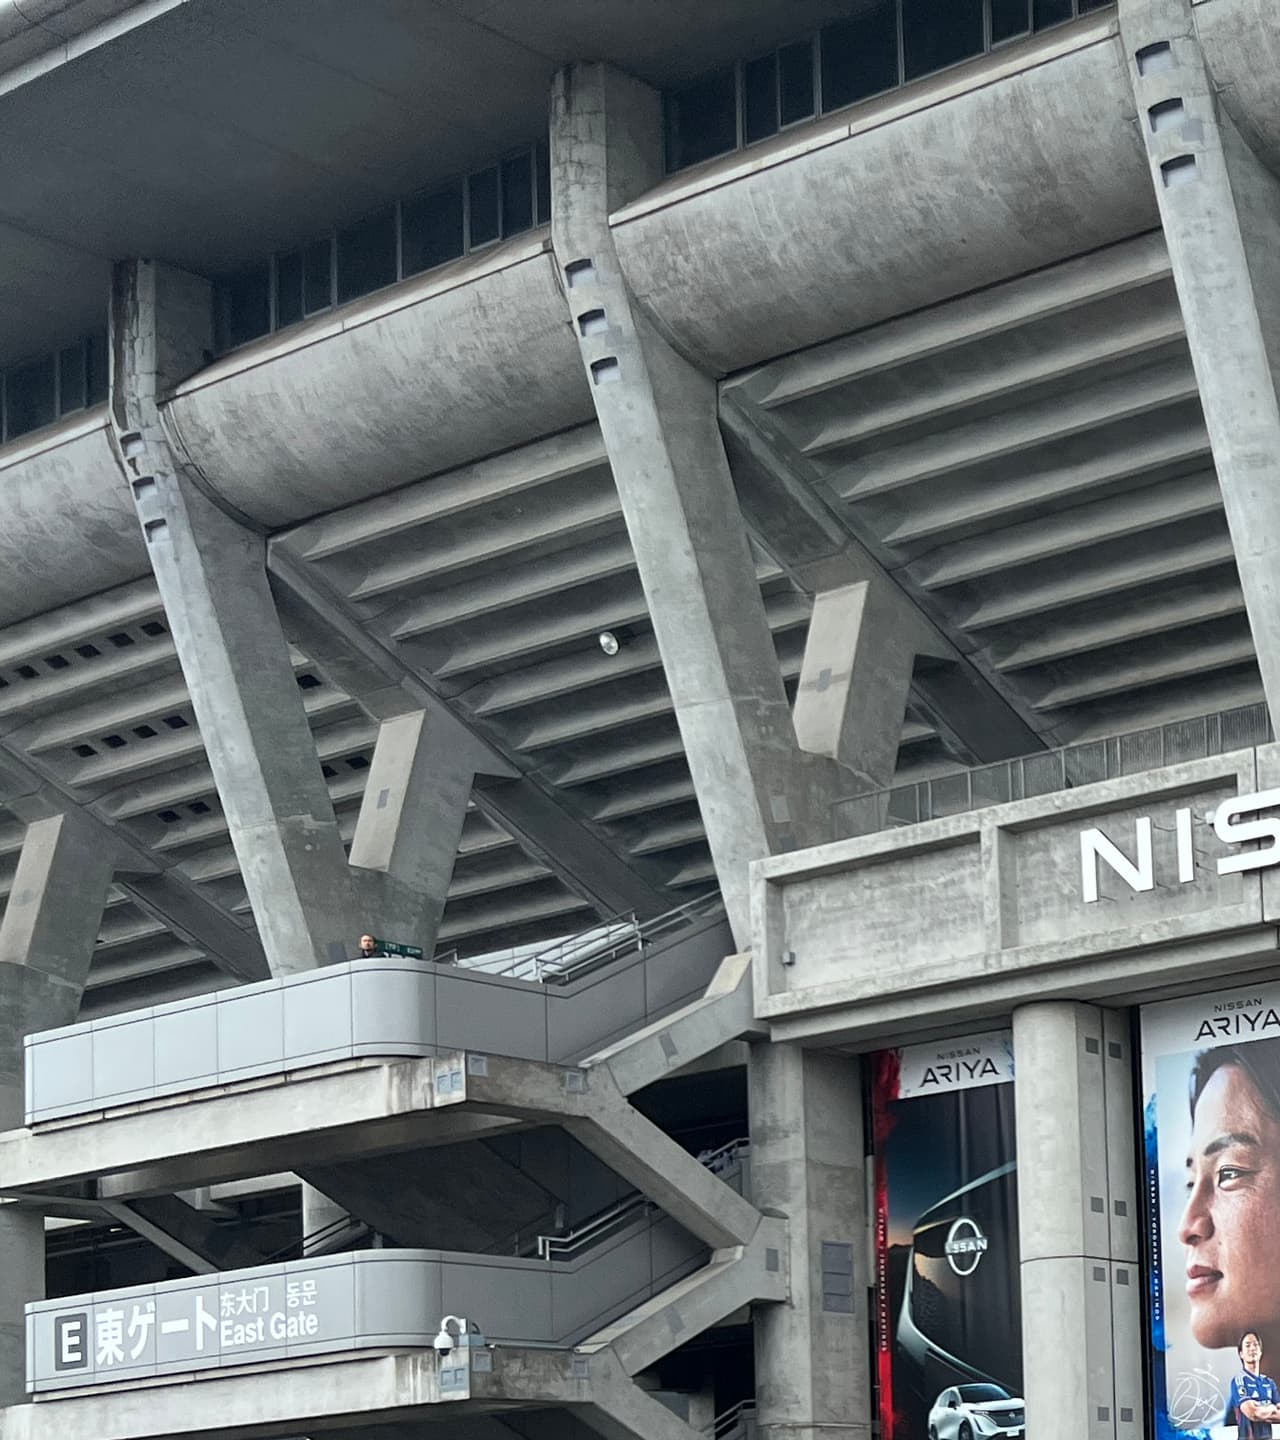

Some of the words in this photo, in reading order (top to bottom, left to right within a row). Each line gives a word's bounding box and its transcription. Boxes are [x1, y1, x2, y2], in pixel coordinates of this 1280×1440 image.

[1213, 998, 1263, 1013] NISSAN
[936, 1047, 981, 1061] NISSAN
[919, 1057, 1000, 1088] ARIYA
[286, 1280, 318, 1309] 동문
[61, 1321, 82, 1363] E
[95, 1296, 217, 1366] 東ゲート
[219, 1316, 265, 1347] East
[269, 1311, 319, 1338] Gate
